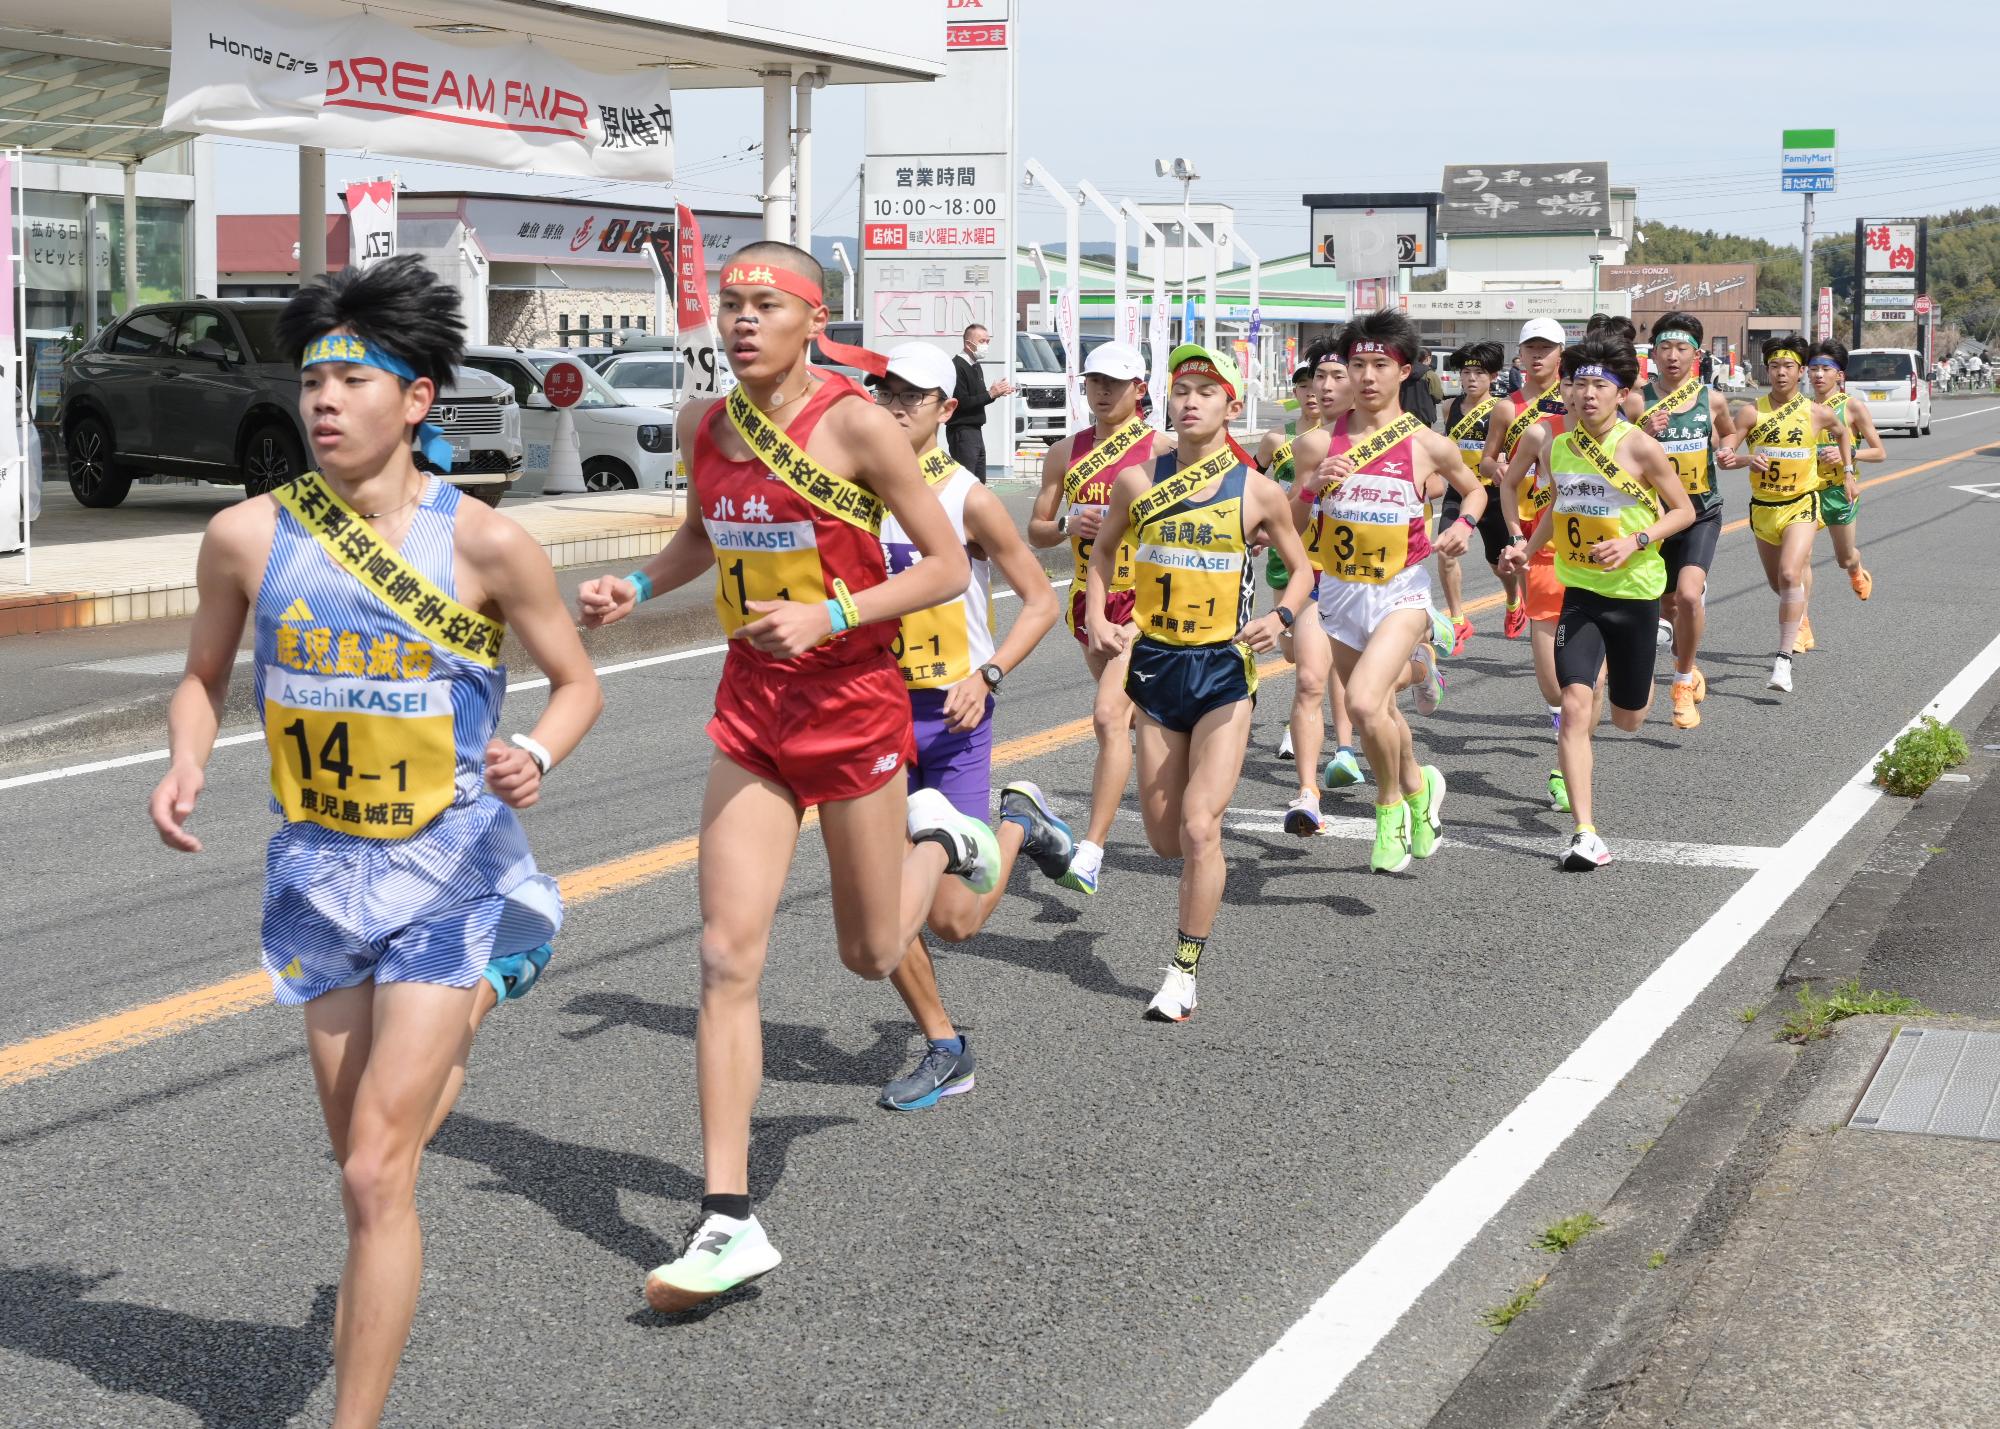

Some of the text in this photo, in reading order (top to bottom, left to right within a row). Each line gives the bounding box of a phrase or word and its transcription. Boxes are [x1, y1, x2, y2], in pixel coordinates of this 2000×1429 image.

[209, 33, 318, 74] Honda Cars
[325, 57, 588, 129] DREAM FAIR
[599, 103, 672, 148] 開催中
[1784, 154, 1832, 164] FamilyMart
[896, 167, 976, 188] 営業時間
[1815, 177, 1833, 188] ATM
[872, 228, 903, 245] 店休日
[1865, 225, 1915, 270] 焼肉
[725, 266, 777, 284] 小林
[879, 265, 991, 287] 中古車
[1457, 300, 1482, 309] さつま
[551, 372, 577, 384] 新車
[548, 386, 581, 398] コーナー
[713, 495, 774, 523] 小林
[1331, 509, 1398, 524] AsahiKASEI
[1560, 505, 1609, 516] AsahiKASEI
[1159, 521, 1232, 546] 福岡第一
[1334, 525, 1386, 563] 3-1
[1149, 550, 1230, 571] AsahiKASEI
[1155, 572, 1216, 617] 1-1
[1151, 613, 1213, 634] 福岡第一
[276, 627, 433, 680] 鹿児島城西
[282, 684, 427, 713] AsahiKASEI
[284, 718, 408, 792] 14-1
[301, 788, 415, 826] 鹿児島城西
